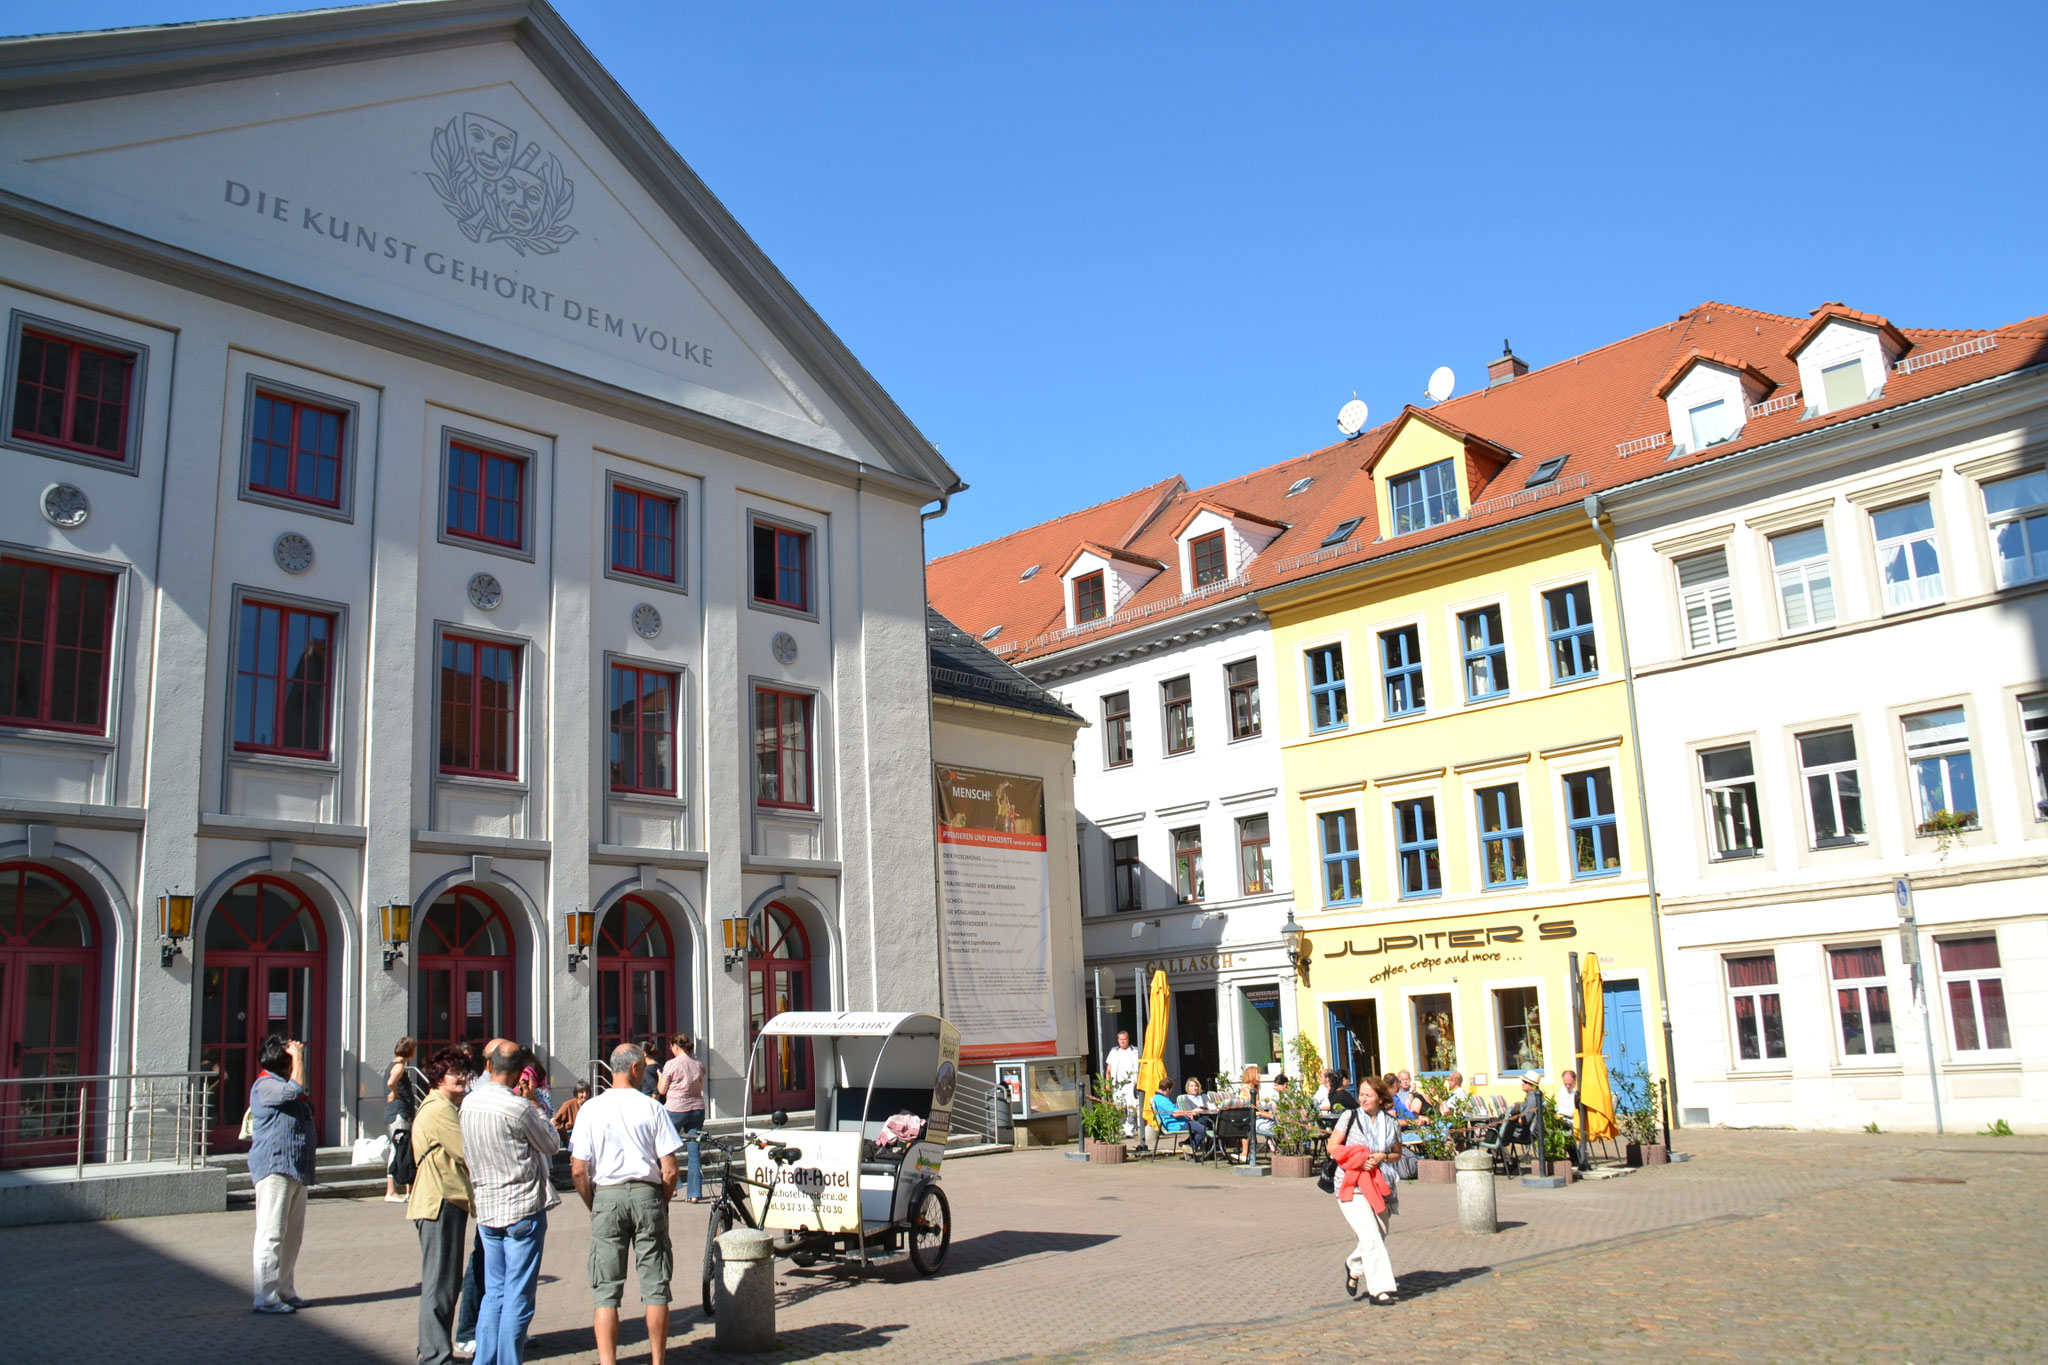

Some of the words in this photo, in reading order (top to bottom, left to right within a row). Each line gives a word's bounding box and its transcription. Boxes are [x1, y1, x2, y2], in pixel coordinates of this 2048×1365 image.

[224, 179, 290, 223] DIE
[302, 207, 418, 266] KUNST
[423, 252, 555, 313] GEHÖRT
[563, 298, 625, 338] DEM
[631, 322, 714, 368] VOLKE
[952, 786, 990, 801] MENSCH!
[943, 831, 974, 841] PREMIEREN
[975, 834, 986, 842] UND
[987, 835, 1013, 845] KONZERTE
[1145, 953, 1233, 976] GALLASCH
[1369, 965, 1408, 984] coffee,
[1410, 956, 1442, 972] crêpe
[1444, 950, 1469, 965] and
[1472, 952, 1502, 962] more
[774, 1021, 893, 1030] STADTRUNDFAHRT
[754, 1166, 850, 1188] Altstadt-Hotel
